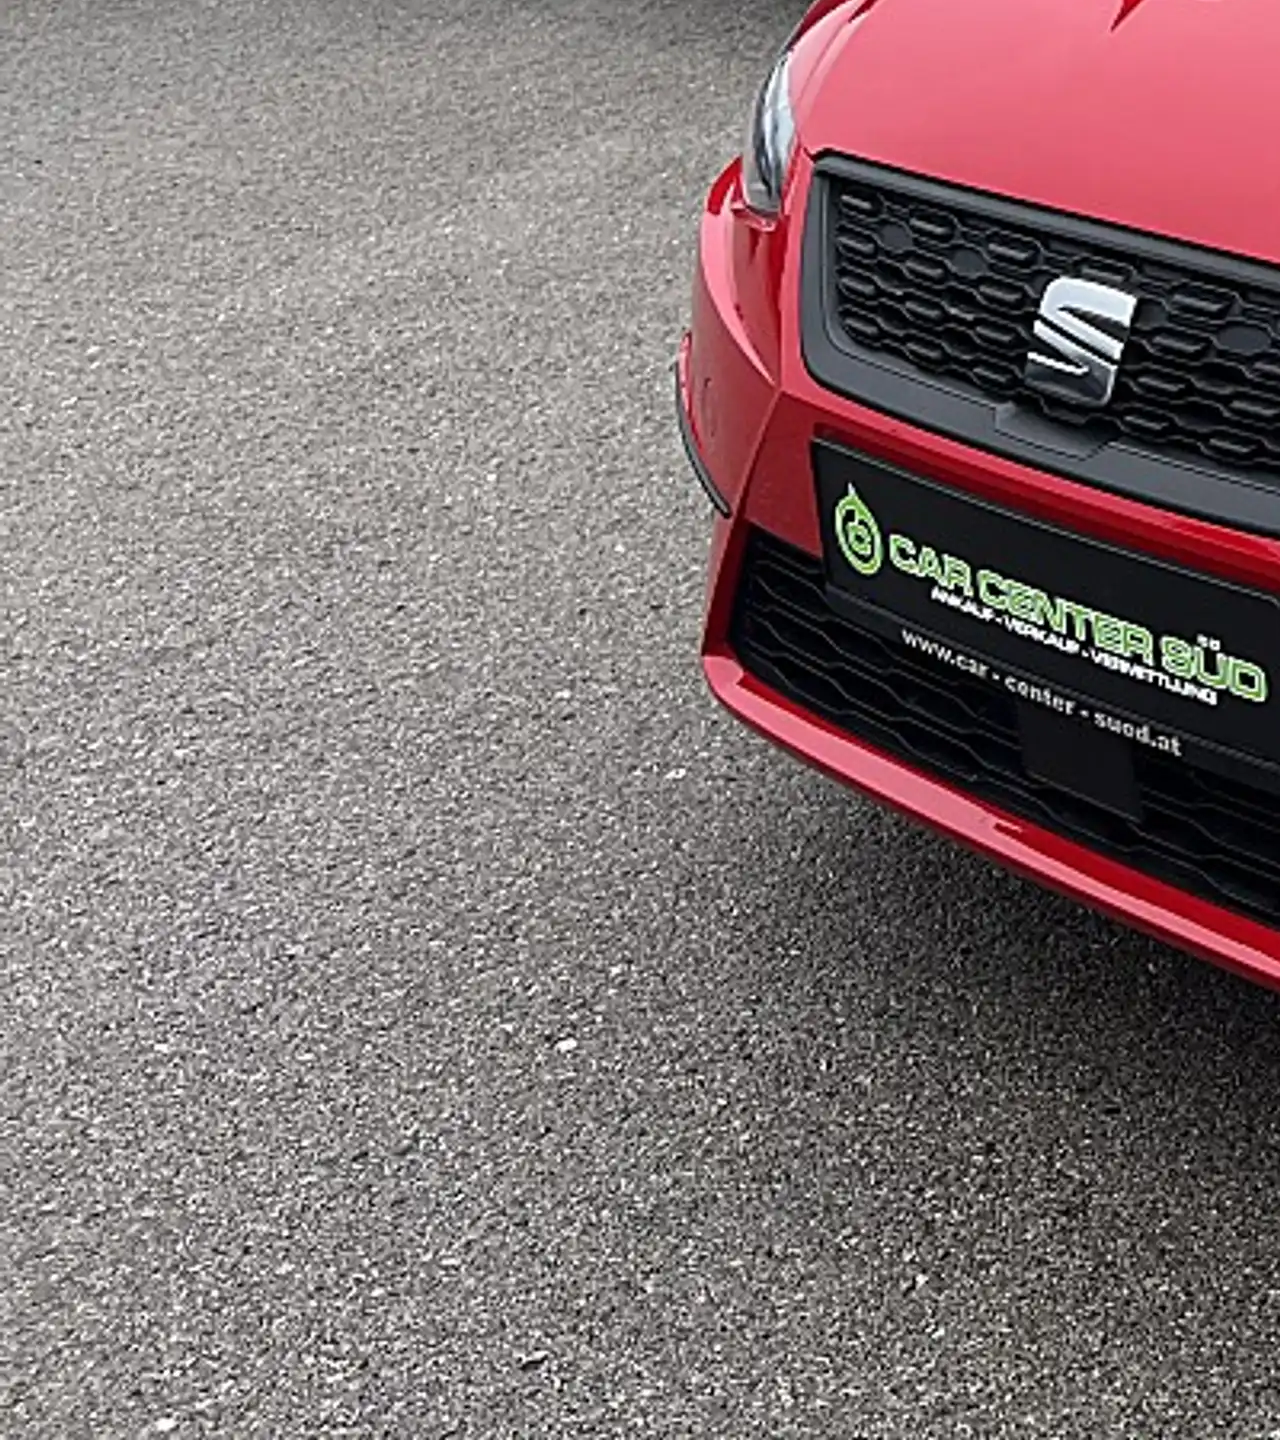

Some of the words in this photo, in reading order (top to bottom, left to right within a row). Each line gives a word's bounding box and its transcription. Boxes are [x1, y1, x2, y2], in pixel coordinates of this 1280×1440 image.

[888, 533, 974, 597] CAR
[976, 569, 1155, 666] CENTER
[1159, 632, 1269, 703] SÜD
[901, 628, 990, 680] www.car
